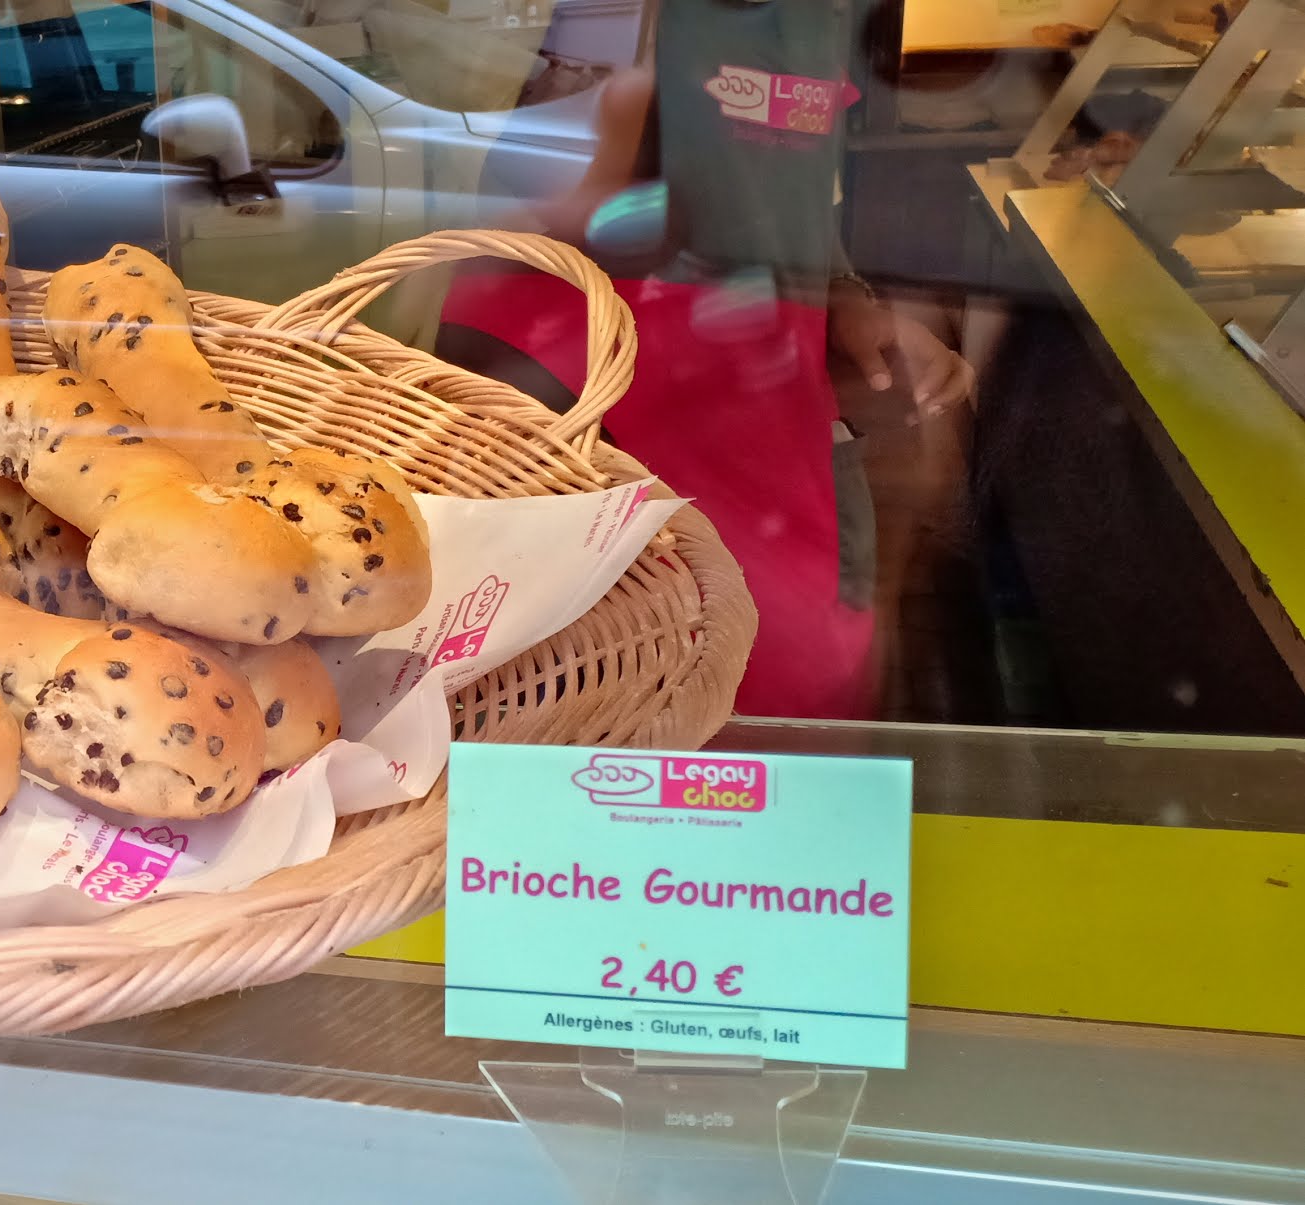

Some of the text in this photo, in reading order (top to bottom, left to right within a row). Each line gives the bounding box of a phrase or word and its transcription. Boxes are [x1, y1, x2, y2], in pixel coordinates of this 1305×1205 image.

[775, 77, 831, 111] Legay
[411, 626, 428, 649] Paris
[667, 760, 757, 789] Legay
[683, 781, 756, 809] choc
[610, 812, 743, 828] Boulangerie Pâtisserie
[84, 861, 129, 898] choc
[107, 856, 168, 902] Legay
[461, 857, 895, 918] Brioche Gourmande
[601, 956, 744, 997] 2,40 €
[544, 1012, 633, 1032] Allergènes
[650, 1018, 713, 1039] Gluten,
[718, 1026, 768, 1043] œufs,
[773, 1028, 801, 1044] lait
